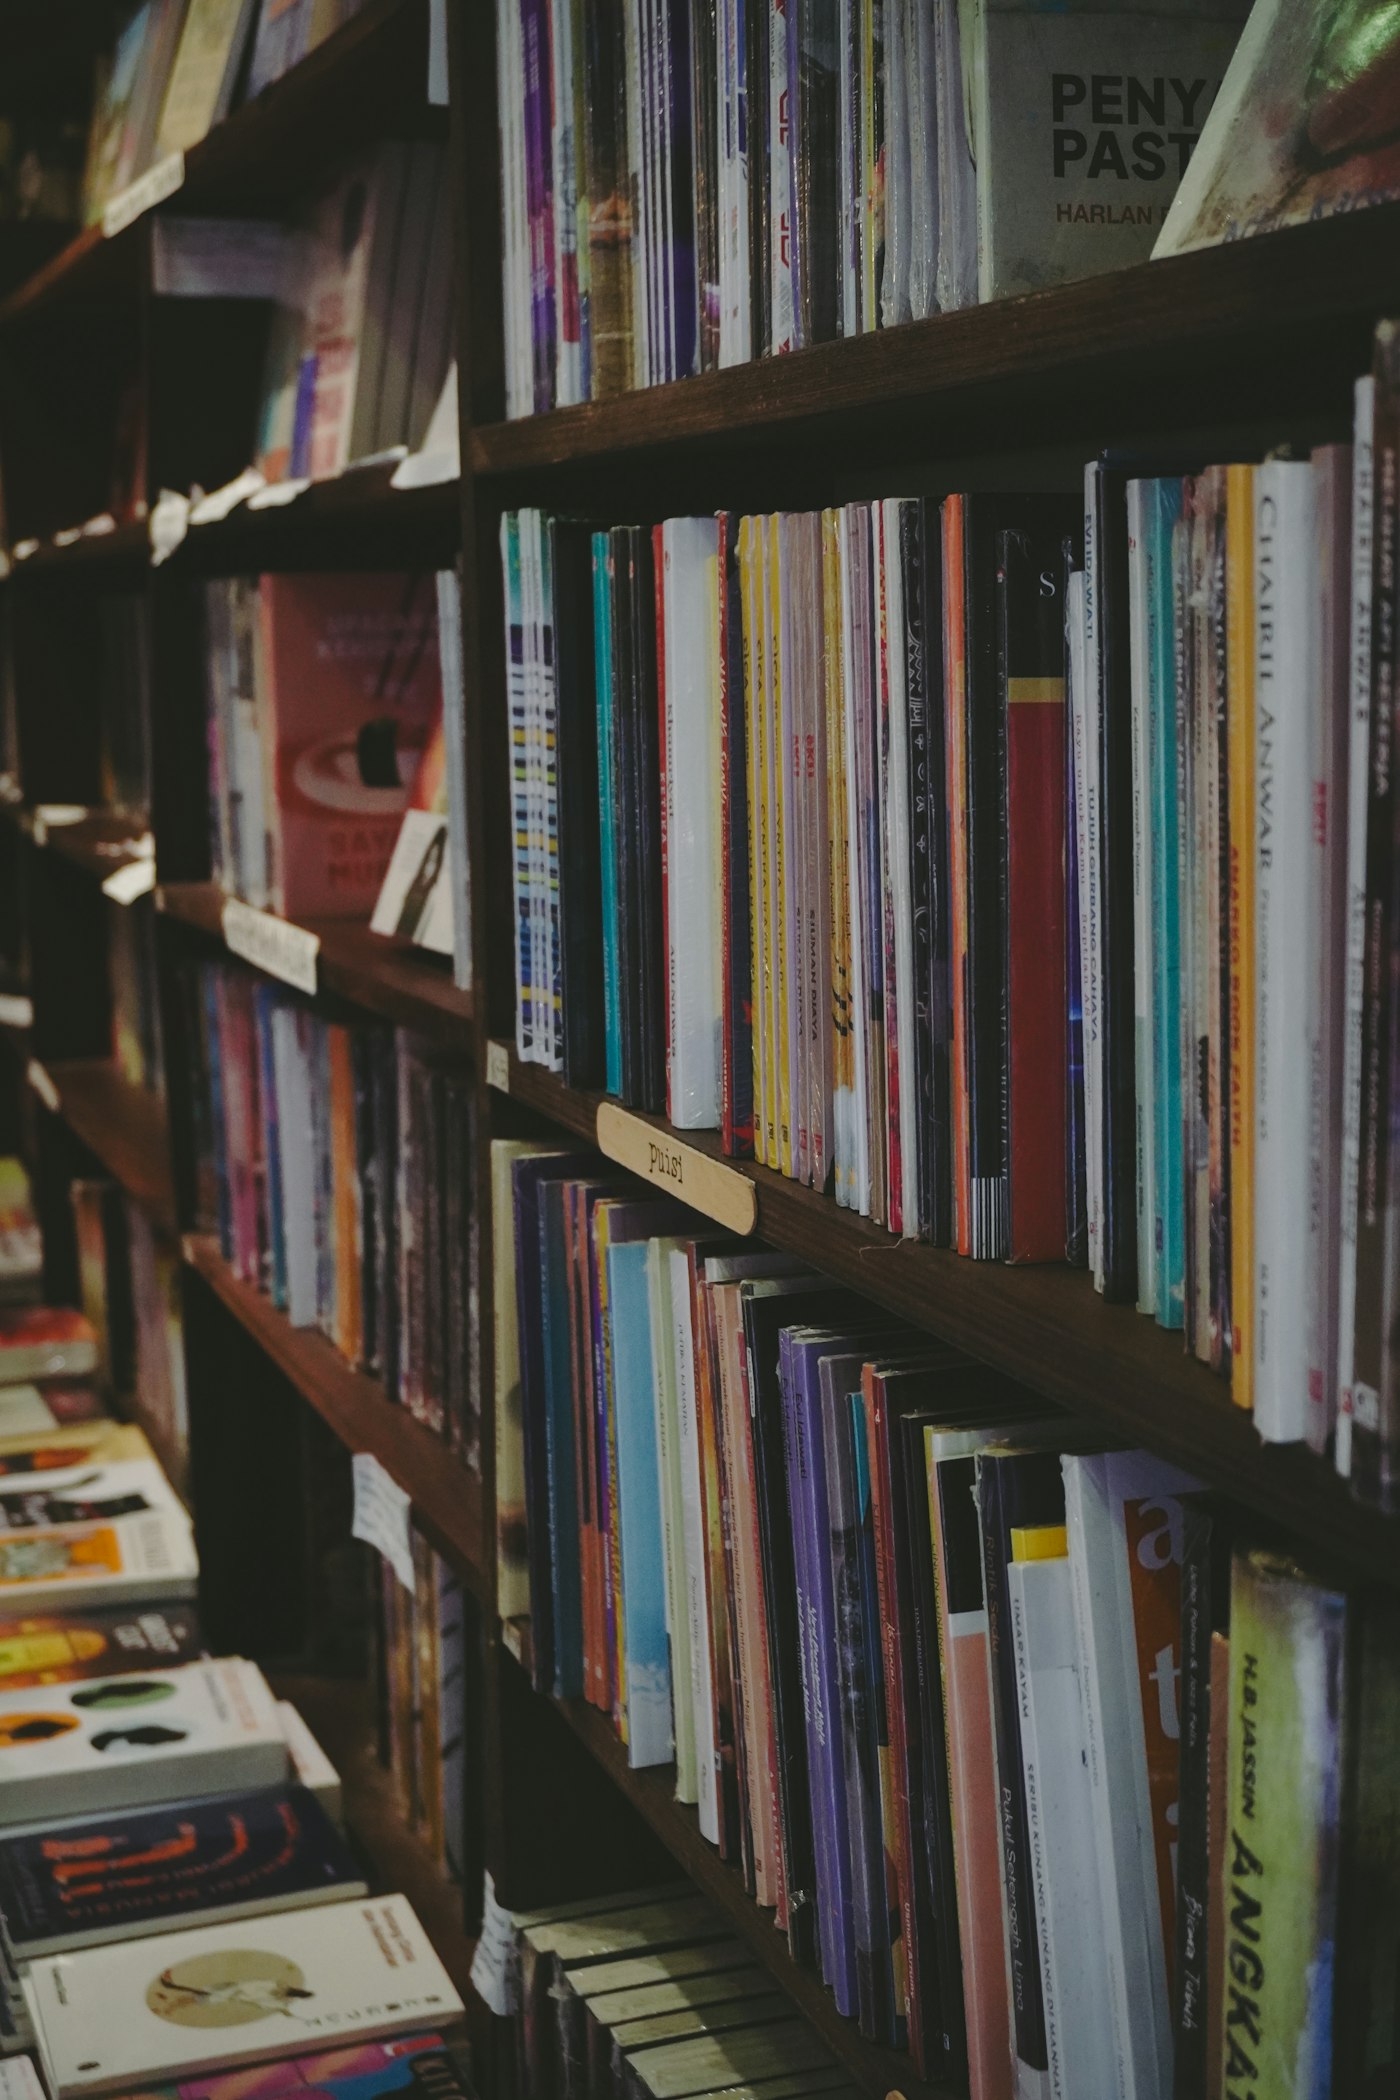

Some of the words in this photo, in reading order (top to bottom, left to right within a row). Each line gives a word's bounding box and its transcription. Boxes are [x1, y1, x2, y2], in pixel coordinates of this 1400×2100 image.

[1051, 73, 1222, 127] PENY
[1055, 204, 1153, 225] HARLAN
[1039, 571, 1056, 598] S
[1259, 496, 1277, 686] CHAIRIL
[1259, 705, 1277, 870] ANWAR
[648, 1141, 684, 1184] puisi
[798, 1420, 807, 1478] Idawati
[1136, 1497, 1184, 1572] a
[986, 1536, 996, 1592] Rintik
[989, 1599, 999, 1657] Sedu
[1014, 1598, 1023, 1652] UMAR
[1018, 1657, 1028, 1717] KAYAM
[1240, 1712, 1257, 1820] JASSIN
[1001, 1787, 1013, 1844] Pukul
[1005, 1848, 1022, 1949] Setengah
[1027, 1763, 1038, 1826] SERIBU
[1046, 1998, 1054, 2017] DI
[1013, 1958, 1025, 2011] Lima
[1182, 1969, 1200, 2031] Tubuh
